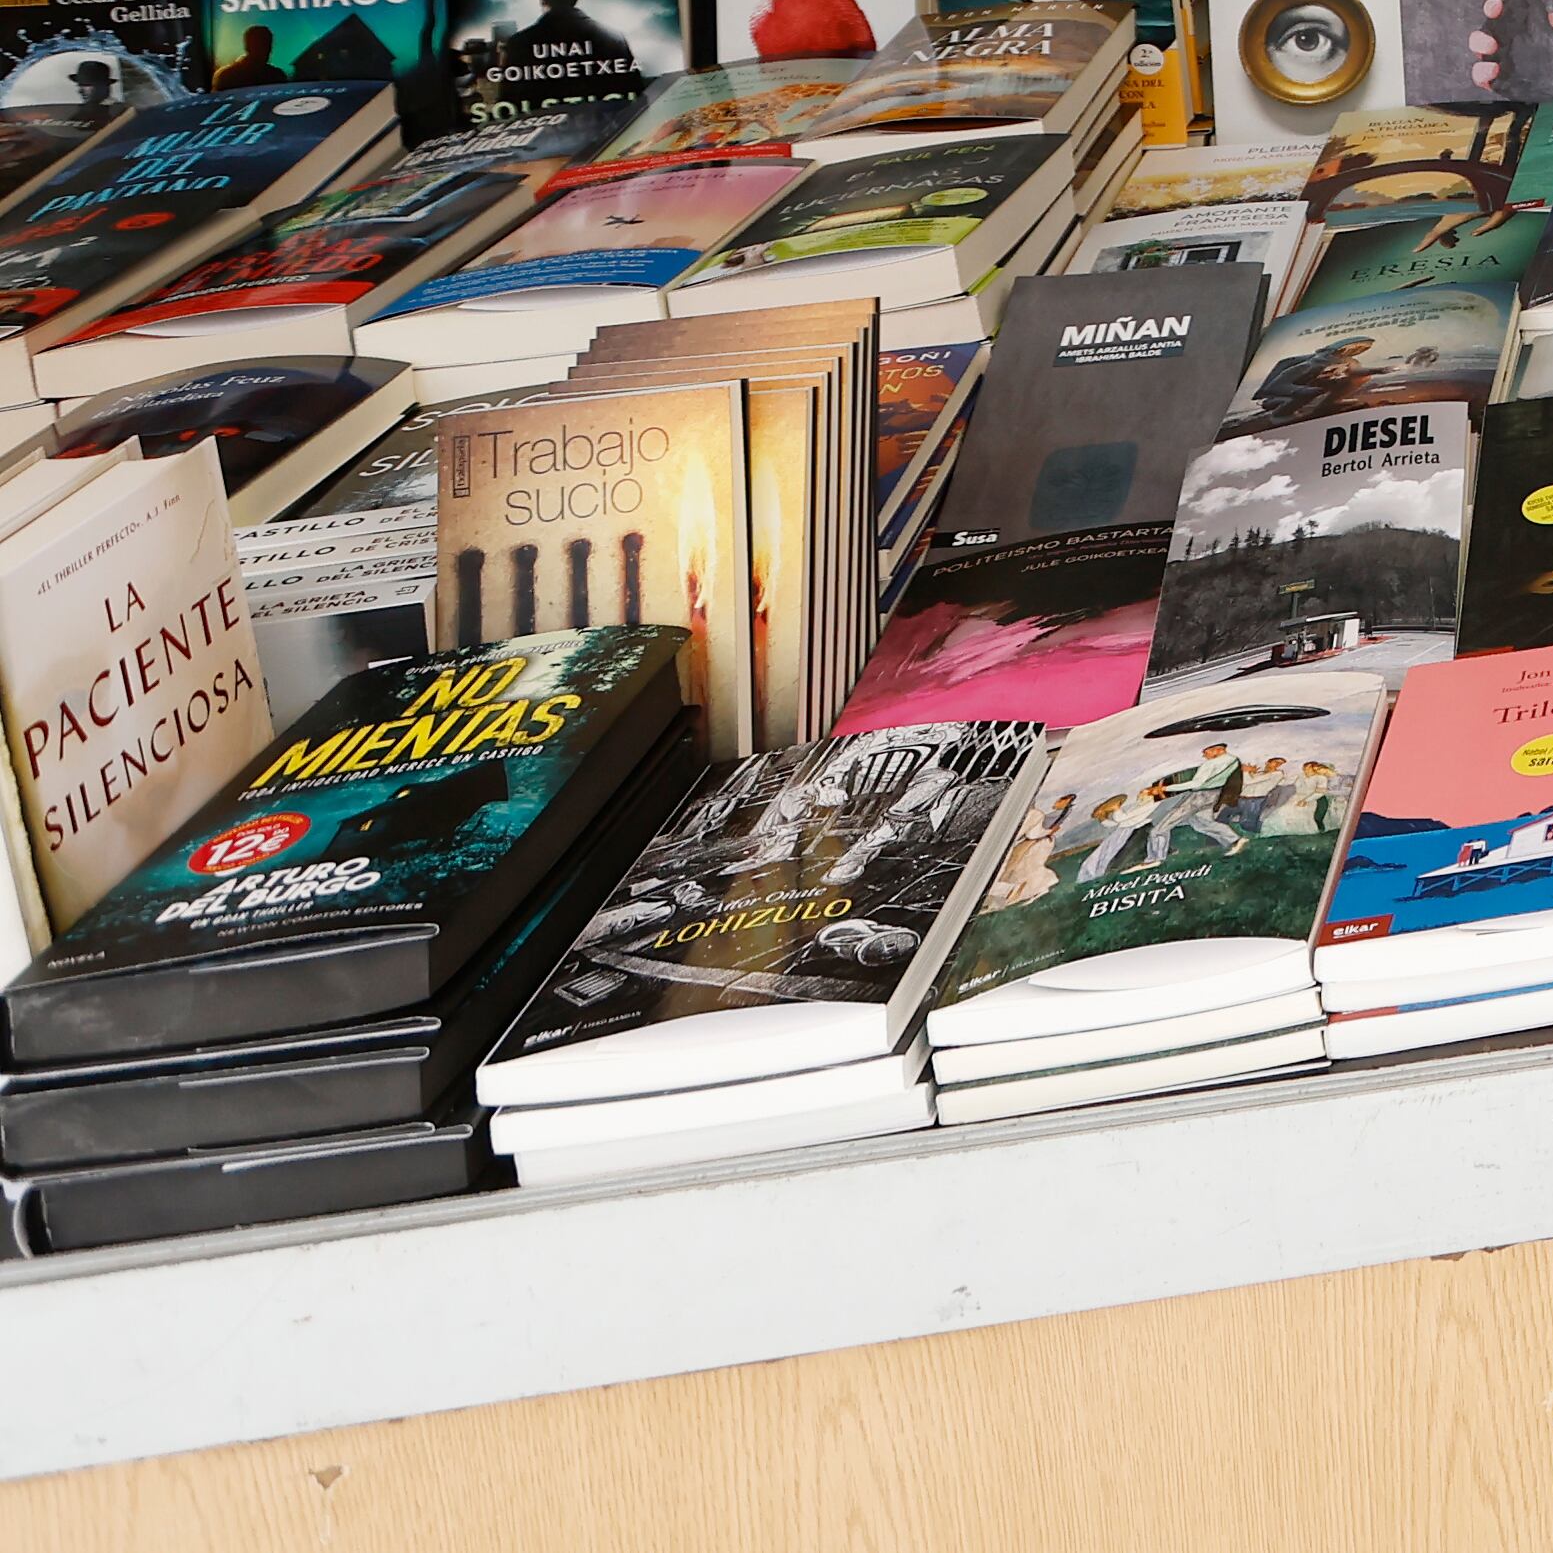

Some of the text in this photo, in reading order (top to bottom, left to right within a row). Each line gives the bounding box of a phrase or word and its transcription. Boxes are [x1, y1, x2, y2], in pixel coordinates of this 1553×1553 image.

[486, 59, 642, 83] GOIKOETXEA
[533, 41, 592, 59] UNAI
[1060, 314, 1192, 346] MIÑAN
[479, 422, 671, 481] Trabajo
[1322, 414, 1434, 457] DIESEL
[1321, 451, 1440, 477] Bertol Arrieta
[504, 473, 644, 527] sucio
[105, 582, 146, 633] LA
[22, 576, 241, 781] PACIENTE
[401, 658, 527, 719] NO
[1516, 669, 1551, 685] Jon
[44, 658, 253, 852] SILENCIOSA
[250, 695, 582, 789] MIENTAS
[155, 872, 382, 925] DEL BURGO
[202, 856, 371, 899] ARTURO
[1089, 886, 1187, 918] BISITA
[654, 897, 853, 950] LOHIZULO
